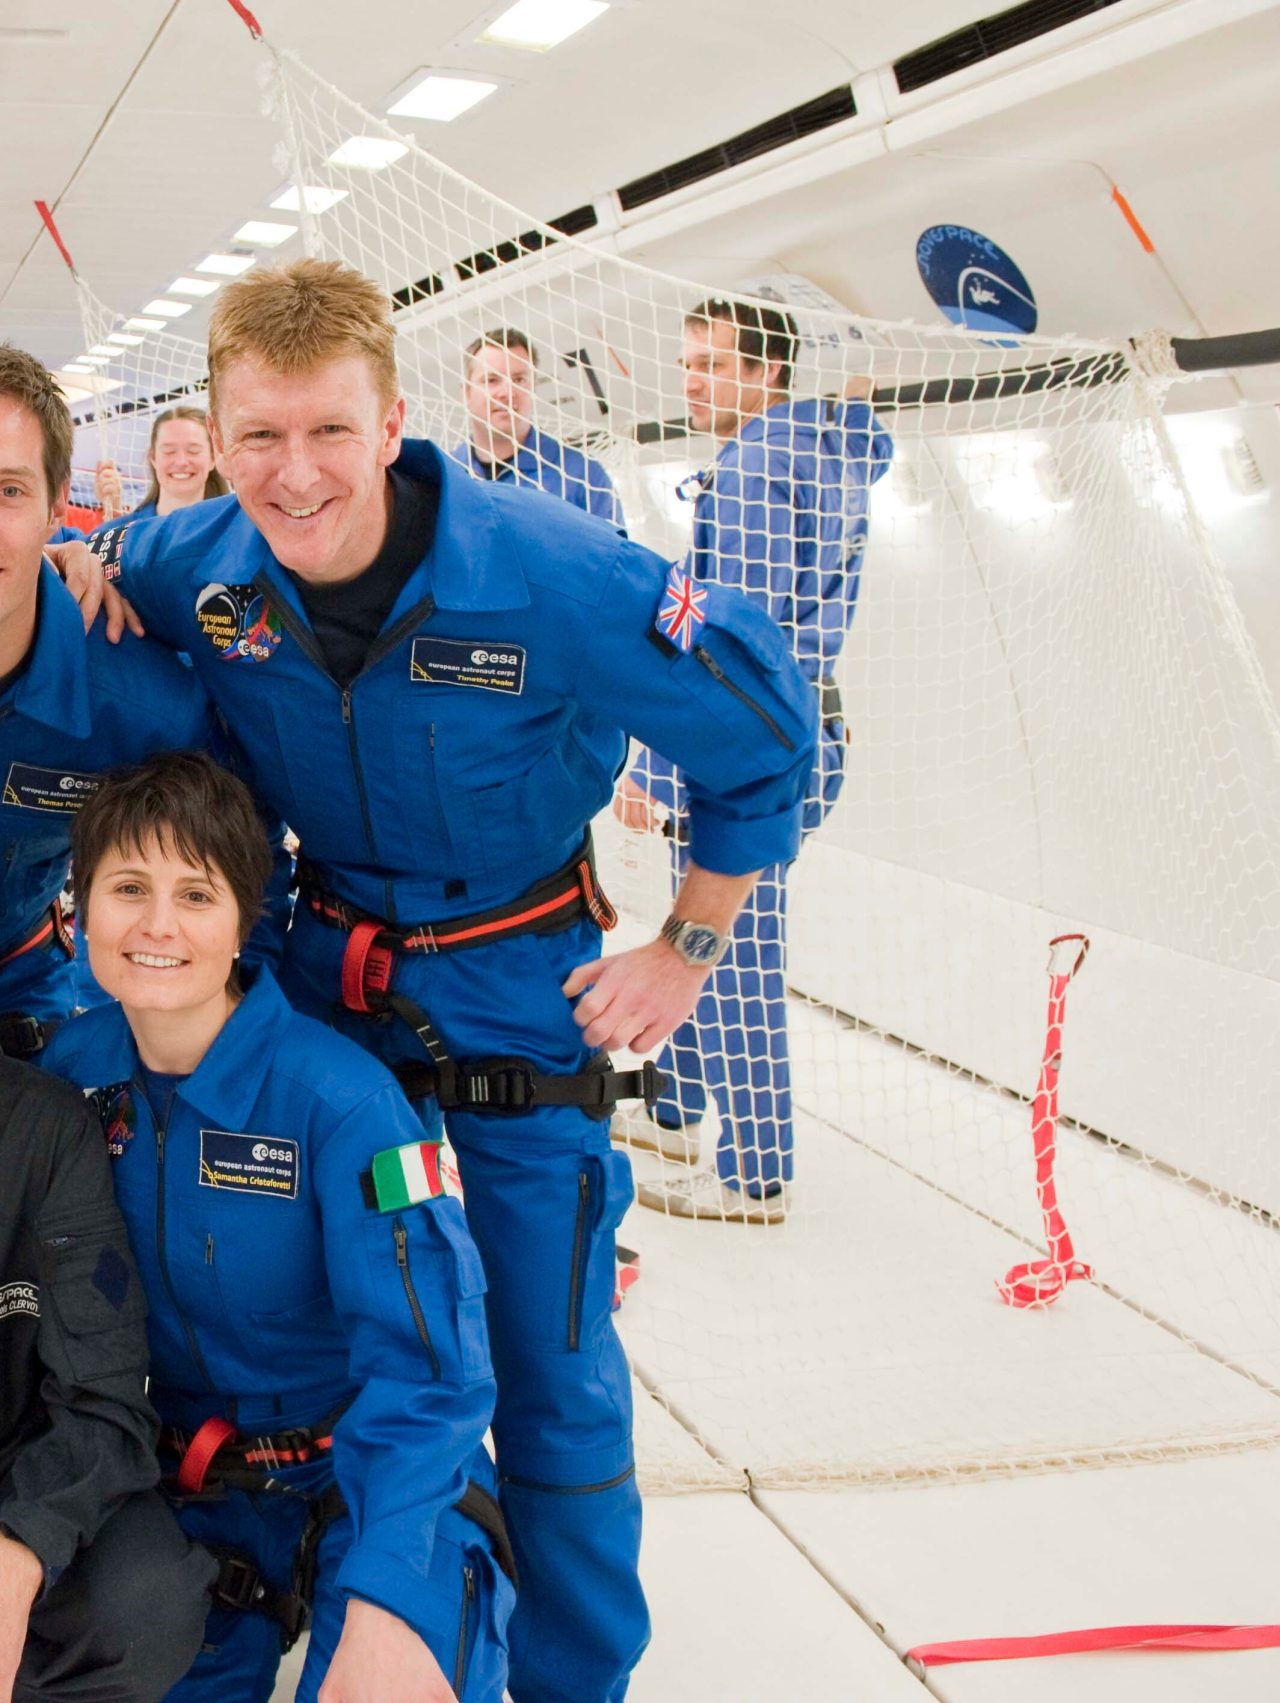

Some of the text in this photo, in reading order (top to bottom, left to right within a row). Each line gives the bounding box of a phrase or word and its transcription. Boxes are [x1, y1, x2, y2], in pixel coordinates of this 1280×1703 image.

[919, 226, 1000, 276] NOVESPACE
[561, 347, 609, 416] 7
[197, 610, 232, 625] European
[202, 622, 237, 637] Astronaut
[212, 634, 232, 649] Corps
[428, 662, 516, 677] european astronaut corps
[20, 785, 49, 795] european
[37, 797, 64, 807] Thomas
[214, 1160, 292, 1177] european astronaut corps
[213, 1171, 248, 1184] Samantha
